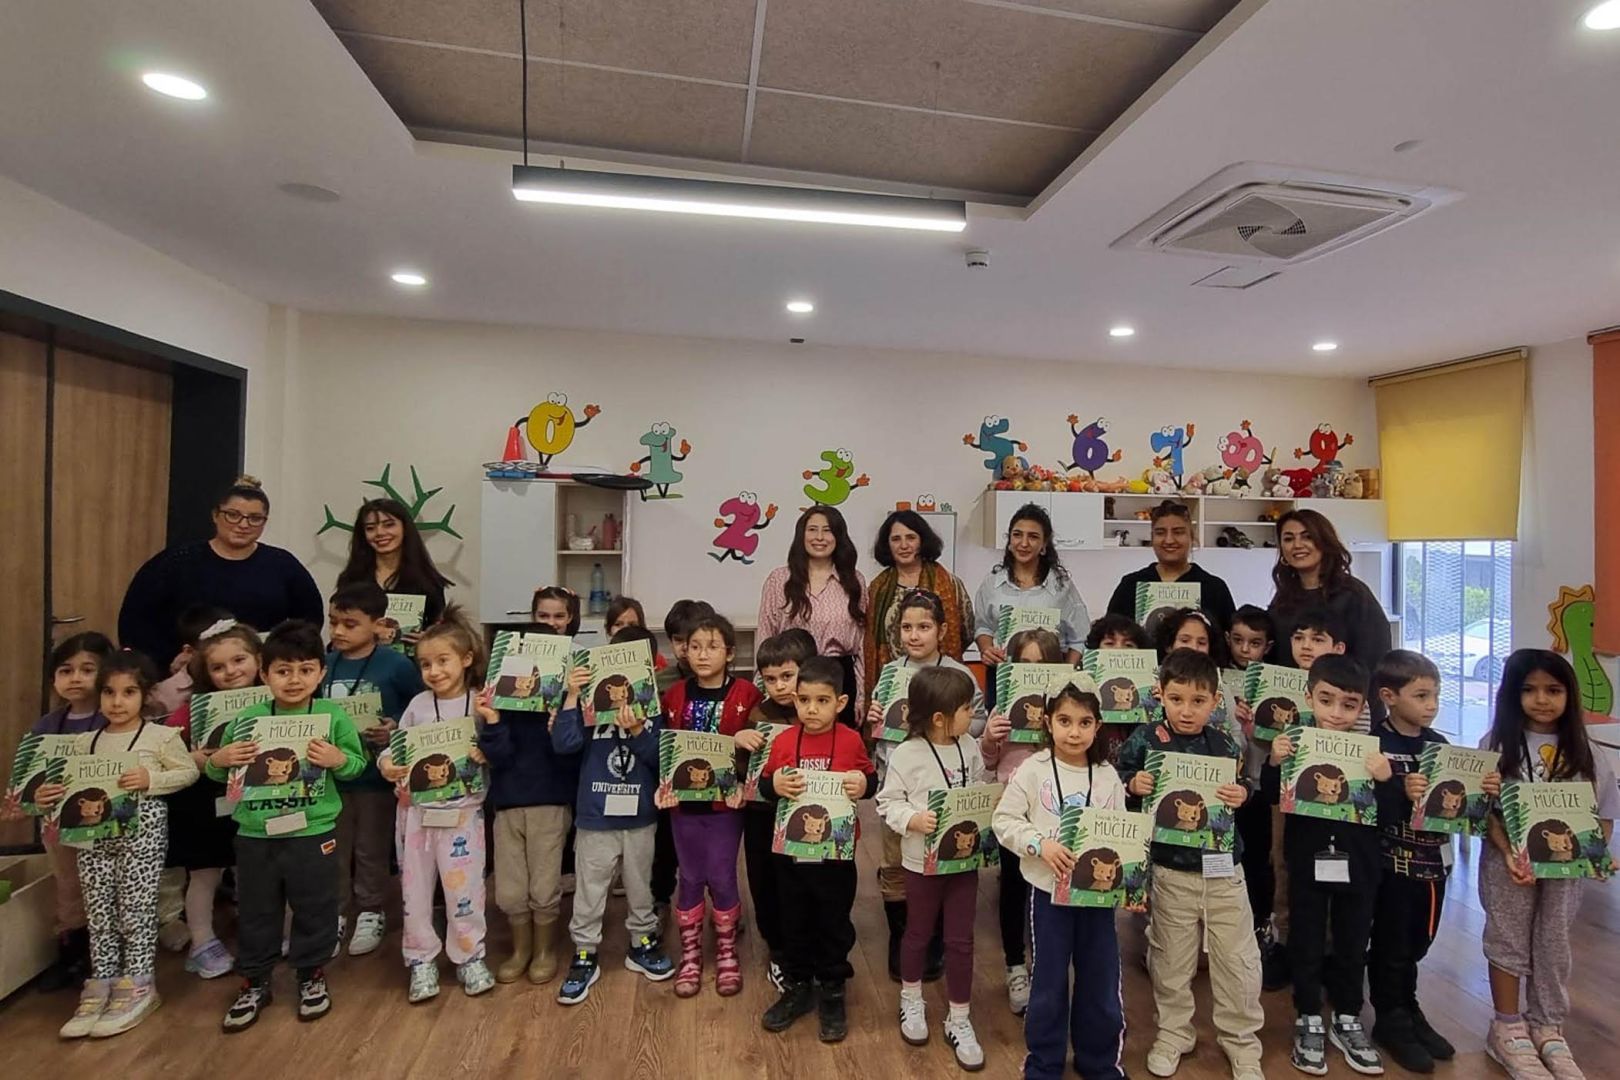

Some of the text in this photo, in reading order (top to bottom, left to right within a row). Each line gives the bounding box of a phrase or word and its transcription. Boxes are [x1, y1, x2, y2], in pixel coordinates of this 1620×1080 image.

[269, 720, 316, 739] MUCİZE
[1315, 738, 1363, 758] MUCİZE
[1176, 762, 1222, 783] MUCİZE
[592, 781, 641, 794] UNIVERSITY
[1533, 788, 1581, 808] MUCİZE
[1094, 818, 1140, 839] MUCİZE
